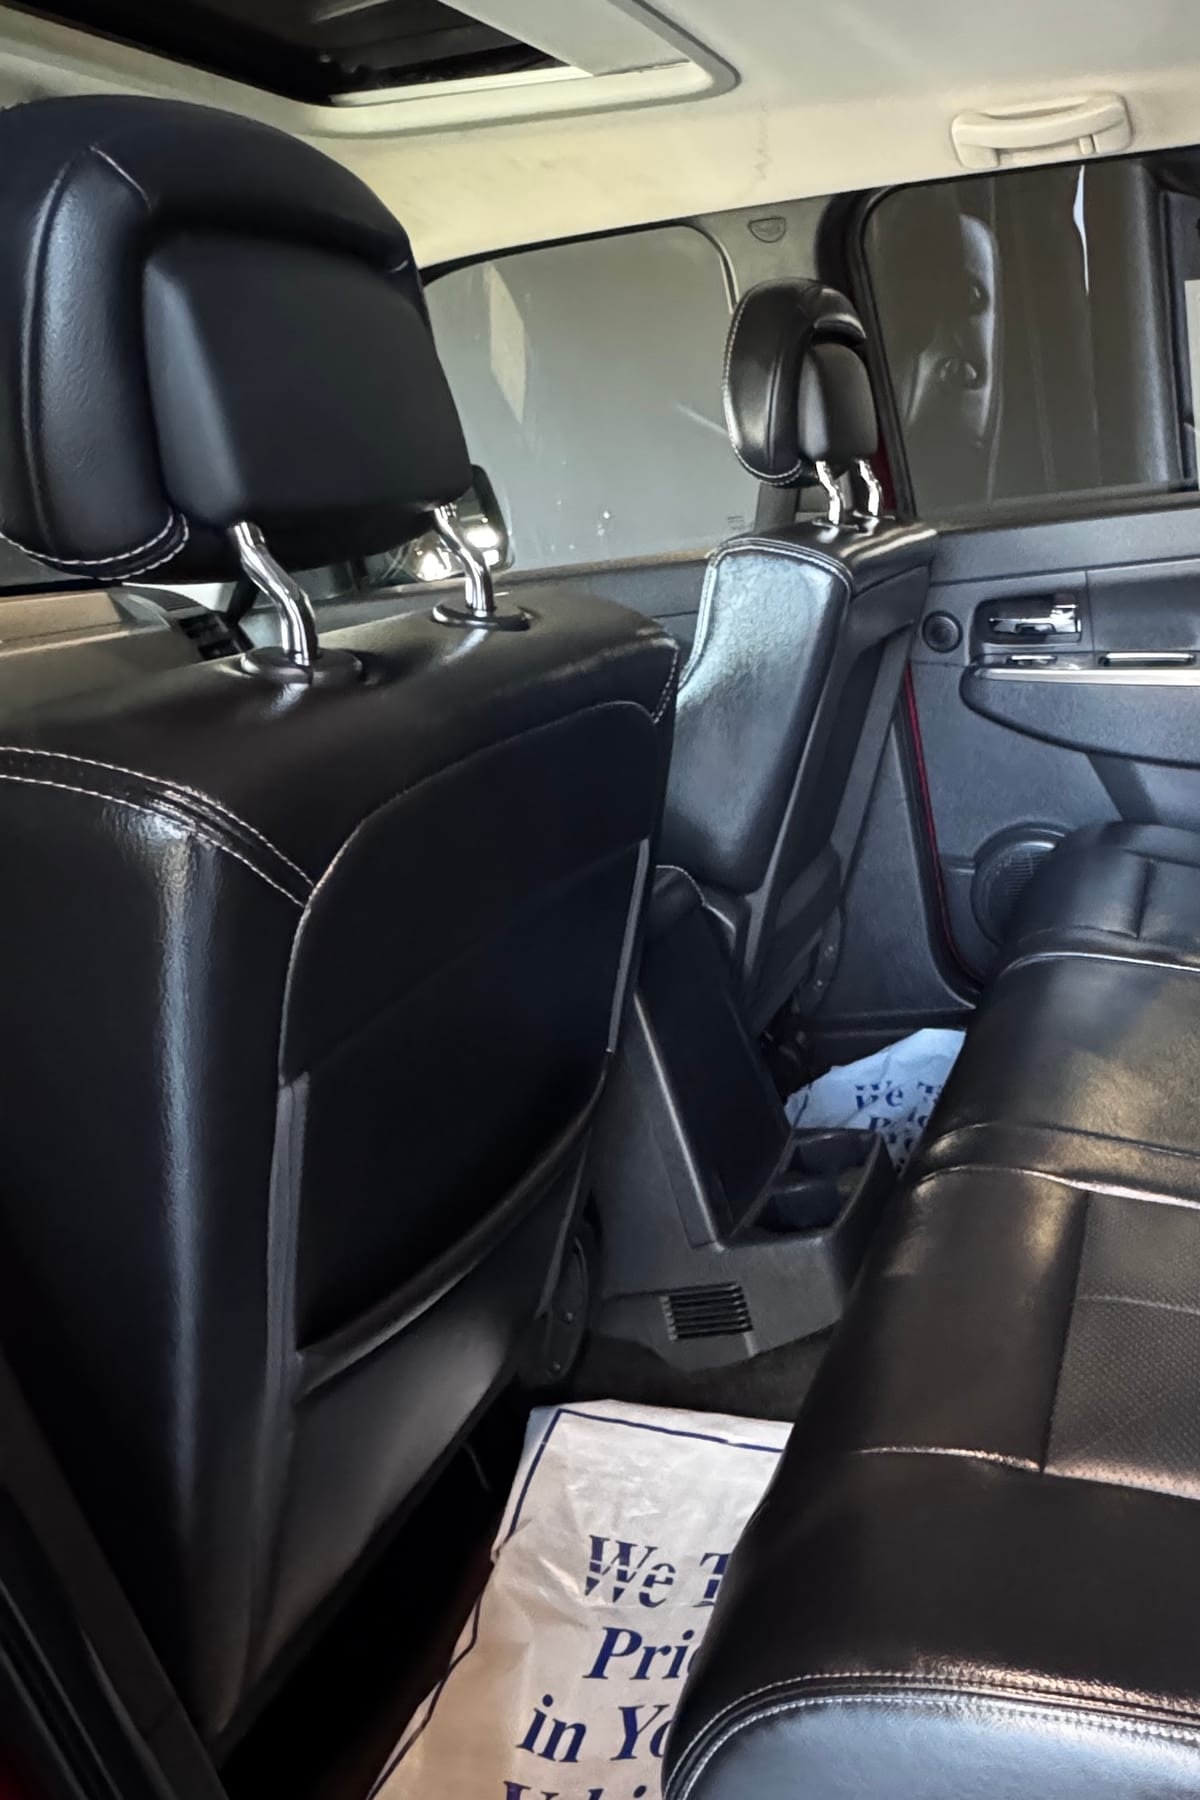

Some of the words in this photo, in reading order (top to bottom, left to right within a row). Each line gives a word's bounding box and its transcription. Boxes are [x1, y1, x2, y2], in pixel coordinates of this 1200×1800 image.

[584, 1534, 676, 1608] We
[582, 1626, 701, 1681] Pri
[515, 1693, 587, 1763] in
